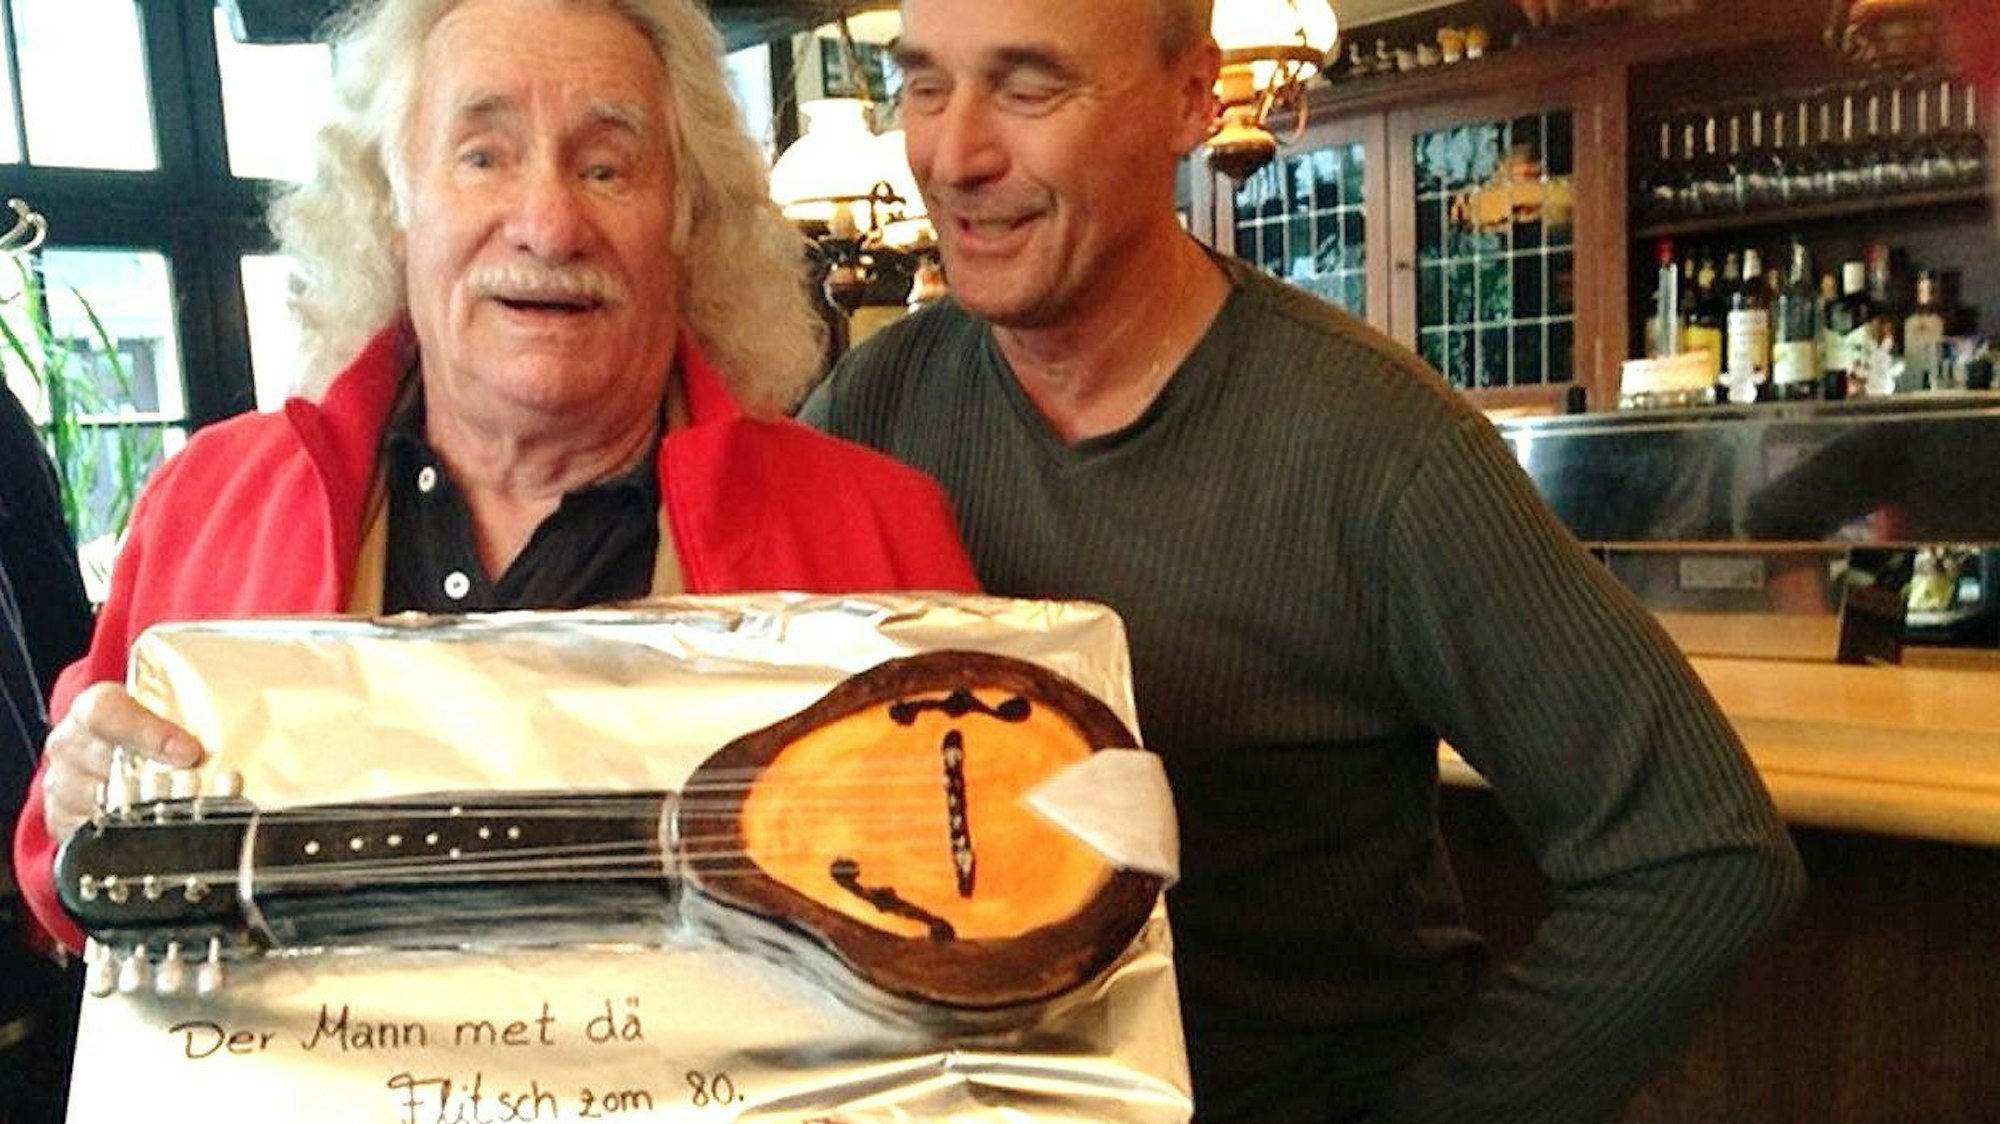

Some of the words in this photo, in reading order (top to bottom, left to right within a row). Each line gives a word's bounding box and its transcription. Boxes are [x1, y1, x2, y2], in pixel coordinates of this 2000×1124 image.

[169, 1021, 276, 1059] Der
[302, 1003, 425, 1052] Mann
[455, 1001, 555, 1046] met
[586, 997, 643, 1043] dä
[387, 1071, 558, 1124] Flitsch
[579, 1087, 653, 1118] zom
[686, 1070, 744, 1107] 80.
